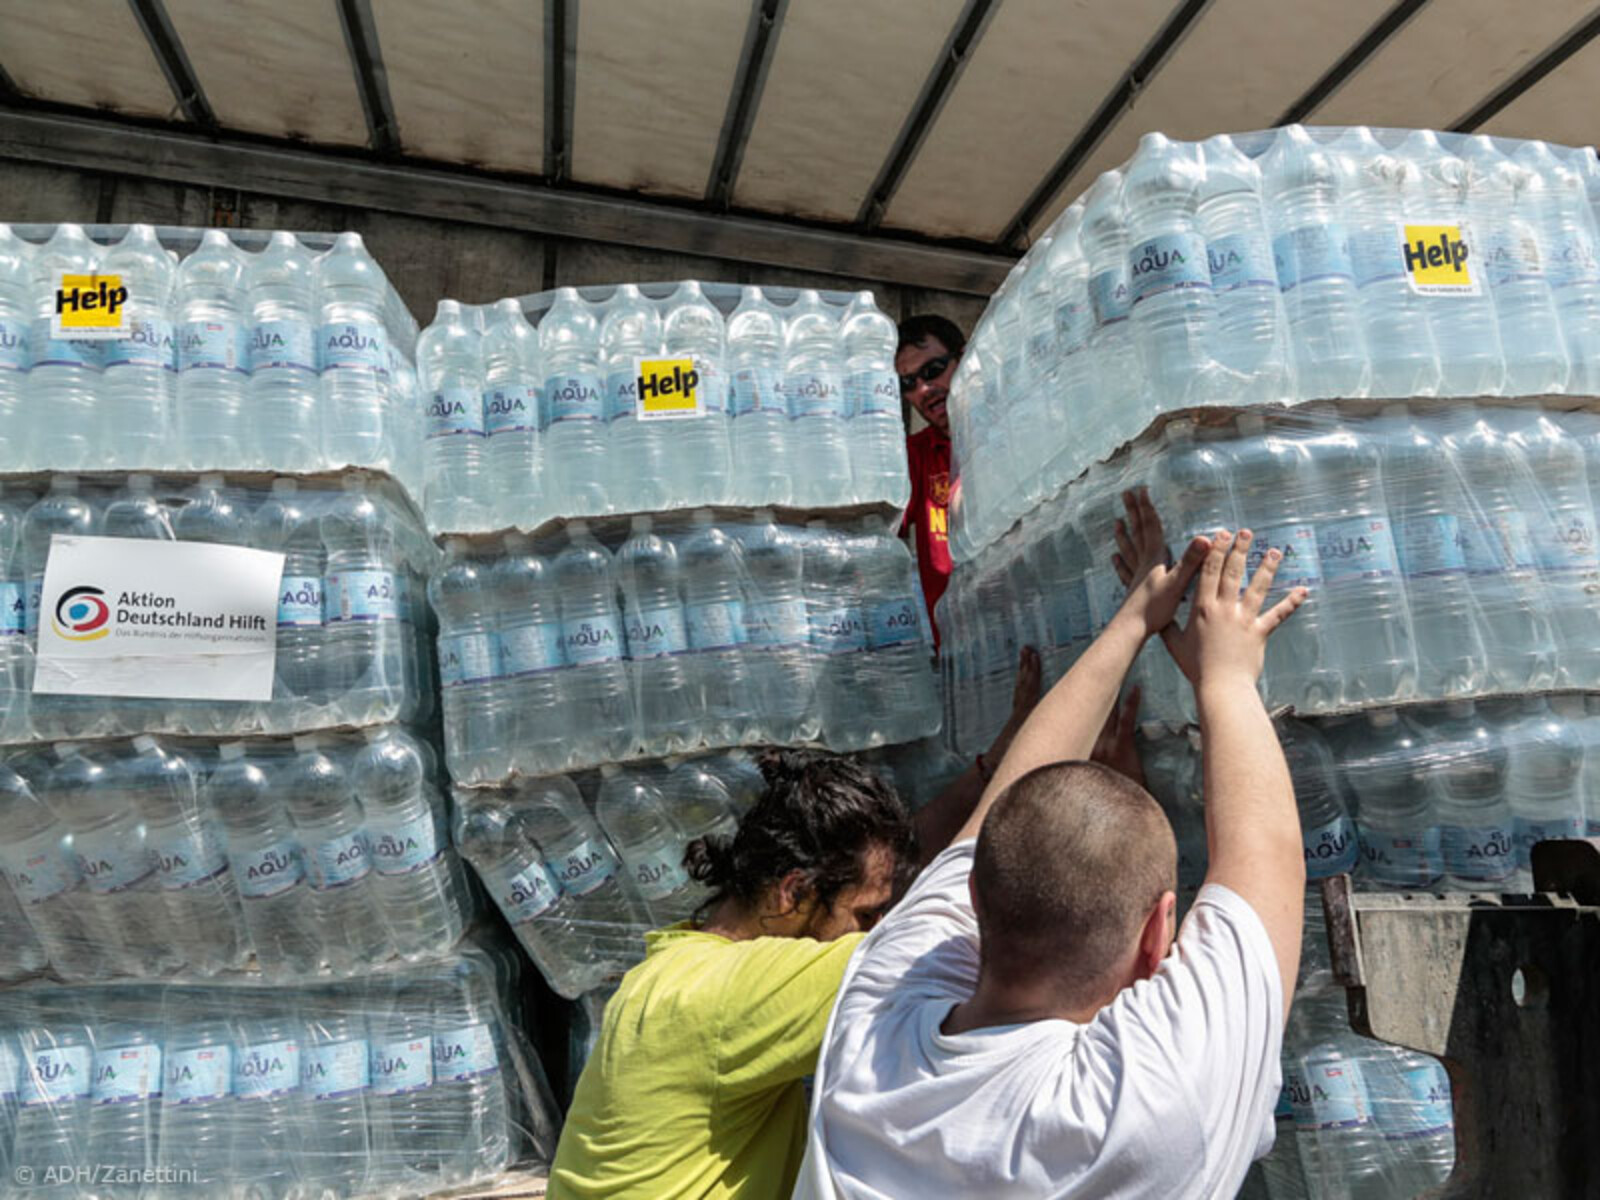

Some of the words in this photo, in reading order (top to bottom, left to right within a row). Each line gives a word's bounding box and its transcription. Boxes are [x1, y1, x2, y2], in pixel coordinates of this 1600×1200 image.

[1131, 249, 1186, 279] AQUA
[1403, 233, 1469, 273] Help
[56, 281, 129, 315] Help
[327, 335, 379, 353] AQUA
[553, 386, 599, 402] AQUA
[637, 366, 699, 401] Help
[117, 591, 176, 609] Aktion
[116, 609, 225, 629] Deutschland
[229, 614, 267, 631] Hilft
[567, 629, 613, 647] AQUA
[561, 851, 603, 881] AQUA
